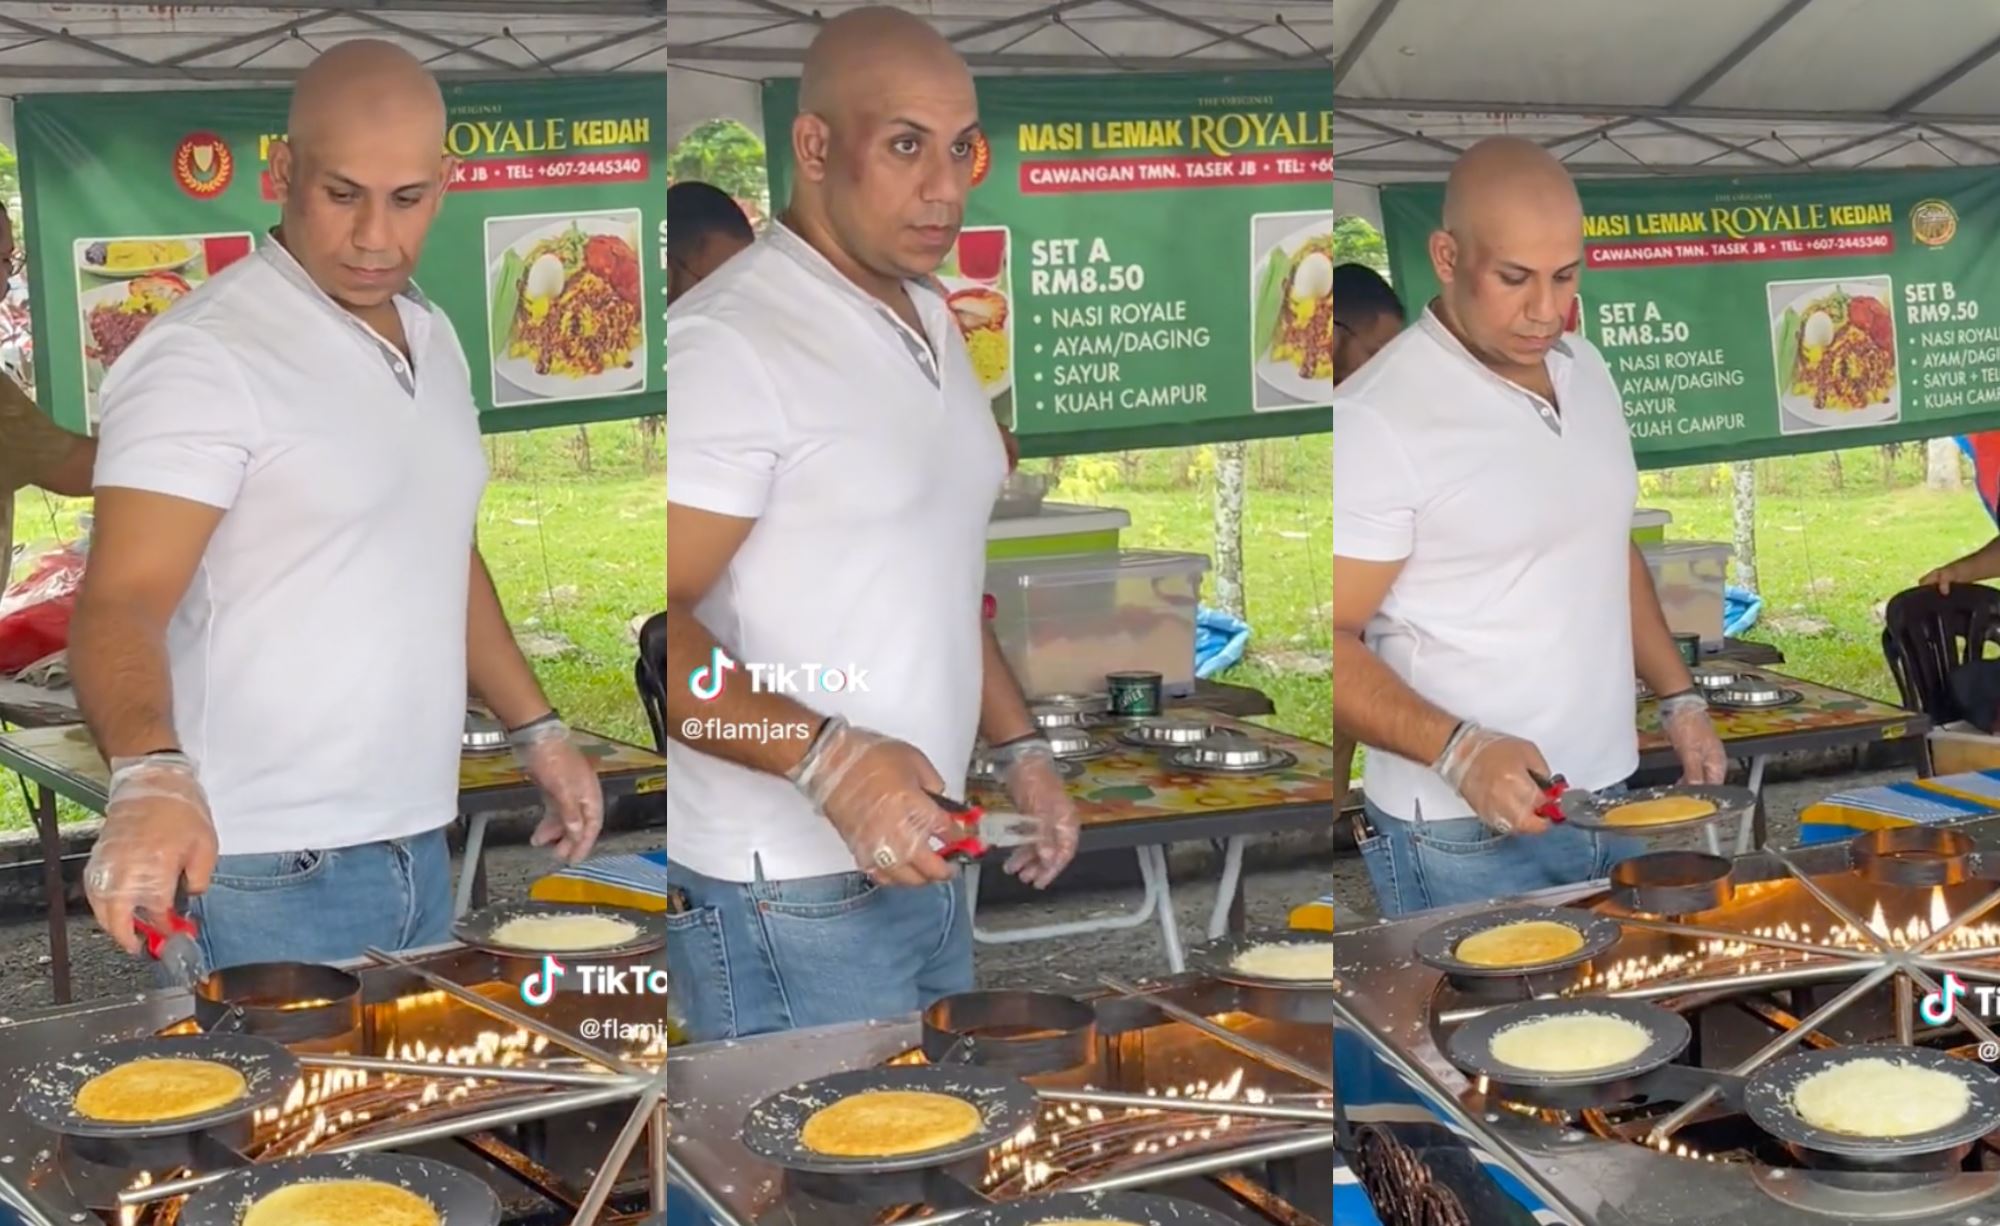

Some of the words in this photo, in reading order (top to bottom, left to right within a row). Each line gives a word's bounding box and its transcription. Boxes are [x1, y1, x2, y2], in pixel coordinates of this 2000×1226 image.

[444, 118, 567, 157] OYALE
[573, 118, 649, 146] KEDAH
[1019, 122, 1083, 151] NASI
[1092, 120, 1183, 149] LEMAK
[470, 167, 488, 182] JB
[506, 165, 534, 179] TEL:
[538, 158, 642, 177] +607-2445340
[1030, 166, 1134, 184] CAWANGAN
[1138, 164, 1181, 180] TMN.
[1185, 162, 1234, 178] TASEK
[1238, 161, 1257, 176] JB
[1276, 159, 1305, 174] TEL:
[1583, 215, 1630, 236] NASI
[1636, 212, 1708, 235] LEMAK
[1711, 204, 1827, 239] ROYALE
[1829, 203, 1892, 226] KEDAH
[1031, 239, 1079, 266] SET
[1088, 237, 1111, 263] A
[1592, 245, 1673, 262] CAWANGAN
[1675, 244, 1709, 259] TMN.
[1712, 243, 1749, 256] TASEK
[1752, 242, 1766, 254] JB
[1780, 240, 1803, 252] TEL:
[1806, 235, 1888, 251] +607-2445340
[1031, 264, 1144, 296] RM8.50
[1905, 283, 1936, 303] SET
[1942, 282, 1955, 300] B
[1051, 305, 1102, 329] NASI
[1110, 301, 1186, 325] ROYALE
[1599, 303, 1636, 324] SET
[1644, 301, 1662, 322] A
[1907, 300, 1979, 325] RM9.50
[1052, 327, 1210, 358] AYAM/DAGING
[1601, 321, 1690, 347] RM8.50
[1921, 331, 1955, 347] NASI
[1958, 327, 2000, 344] ROYAL
[1619, 354, 1660, 372] NASI
[1665, 349, 1724, 368] ROYALE
[1053, 362, 1120, 386] SAYUR
[1622, 370, 1744, 395] AYAM/DAGING
[1924, 371, 1967, 389] SAYUR
[1054, 390, 1113, 414] KUAH
[1120, 383, 1207, 409] CAMPUR
[1624, 398, 1677, 417] SAYUR
[1924, 391, 1963, 409] KUAH
[1677, 413, 1745, 434] CAMPUR
